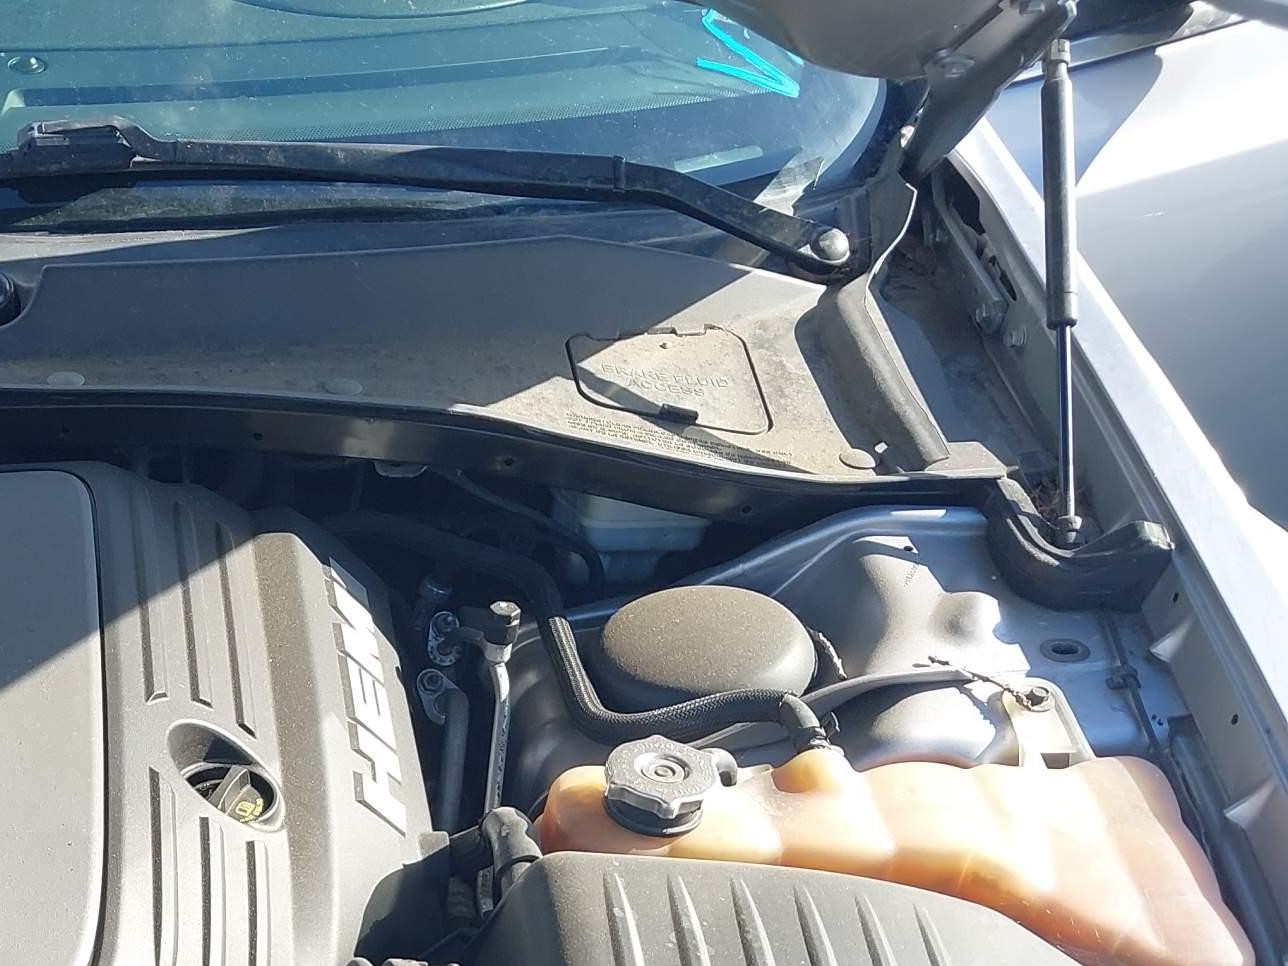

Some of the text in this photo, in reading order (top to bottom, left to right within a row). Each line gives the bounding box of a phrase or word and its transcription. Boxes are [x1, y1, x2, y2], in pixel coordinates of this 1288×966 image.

[601, 359, 729, 388] BRAKE FLUID
[626, 376, 705, 397] ACCESS
[323, 557, 406, 838] HEMI
